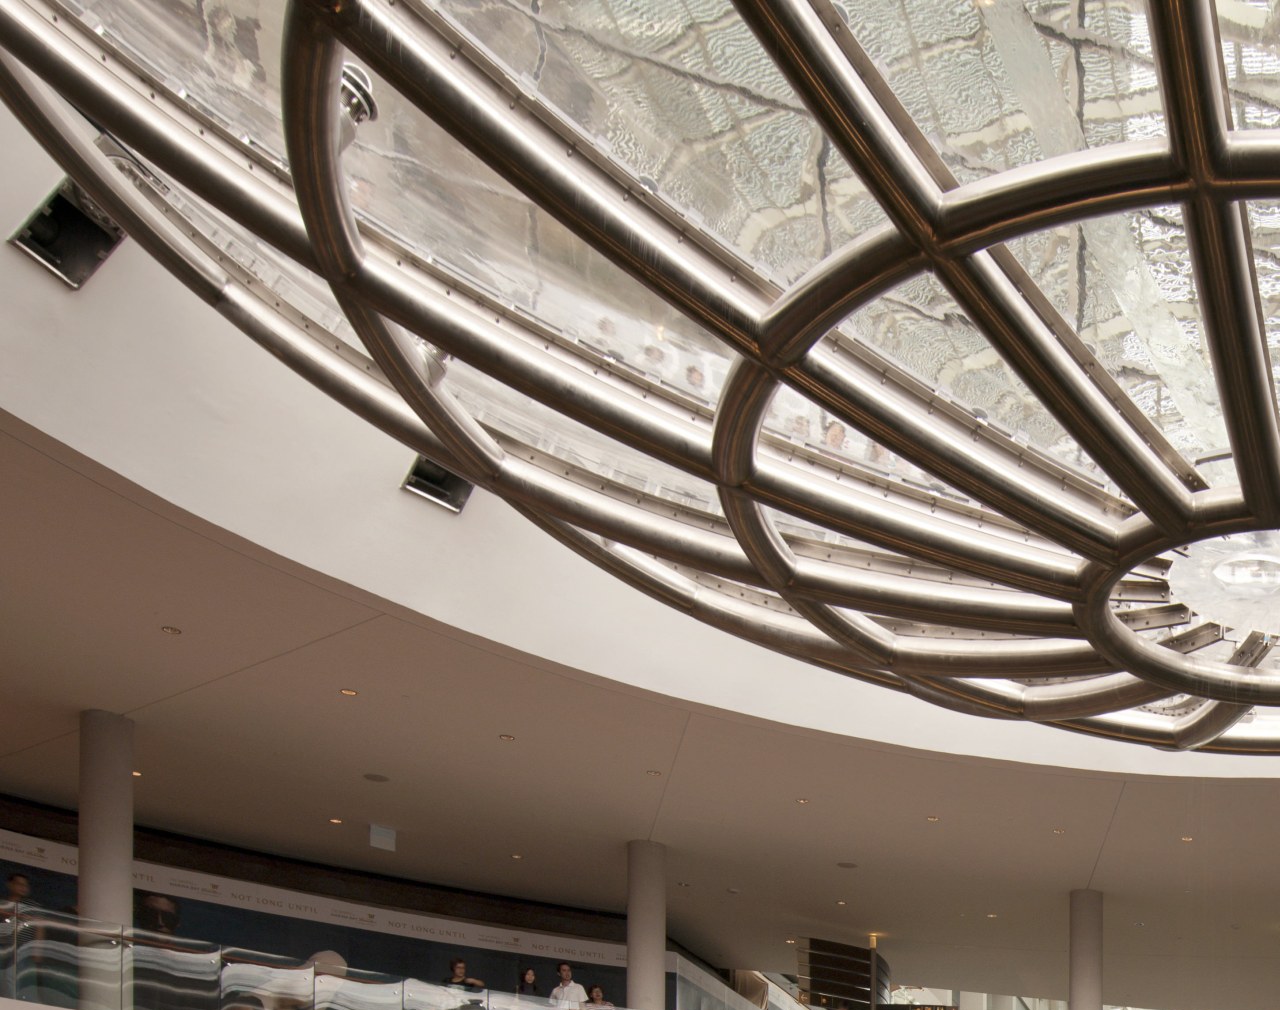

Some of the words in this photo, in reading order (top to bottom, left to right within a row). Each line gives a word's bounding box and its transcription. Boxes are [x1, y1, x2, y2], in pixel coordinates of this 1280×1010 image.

[61, 857, 77, 866] NO
[132, 872, 155, 883] NTIL
[231, 892, 252, 902] NOT
[256, 898, 283, 908] LONG
[288, 903, 318, 914] UNTIL
[388, 920, 407, 929] NOT
[411, 925, 436, 935] LONG
[438, 930, 466, 939] UNTIL
[532, 943, 549, 951] NOT
[553, 947, 577, 956] LONG
[579, 951, 606, 959] UNTIL
